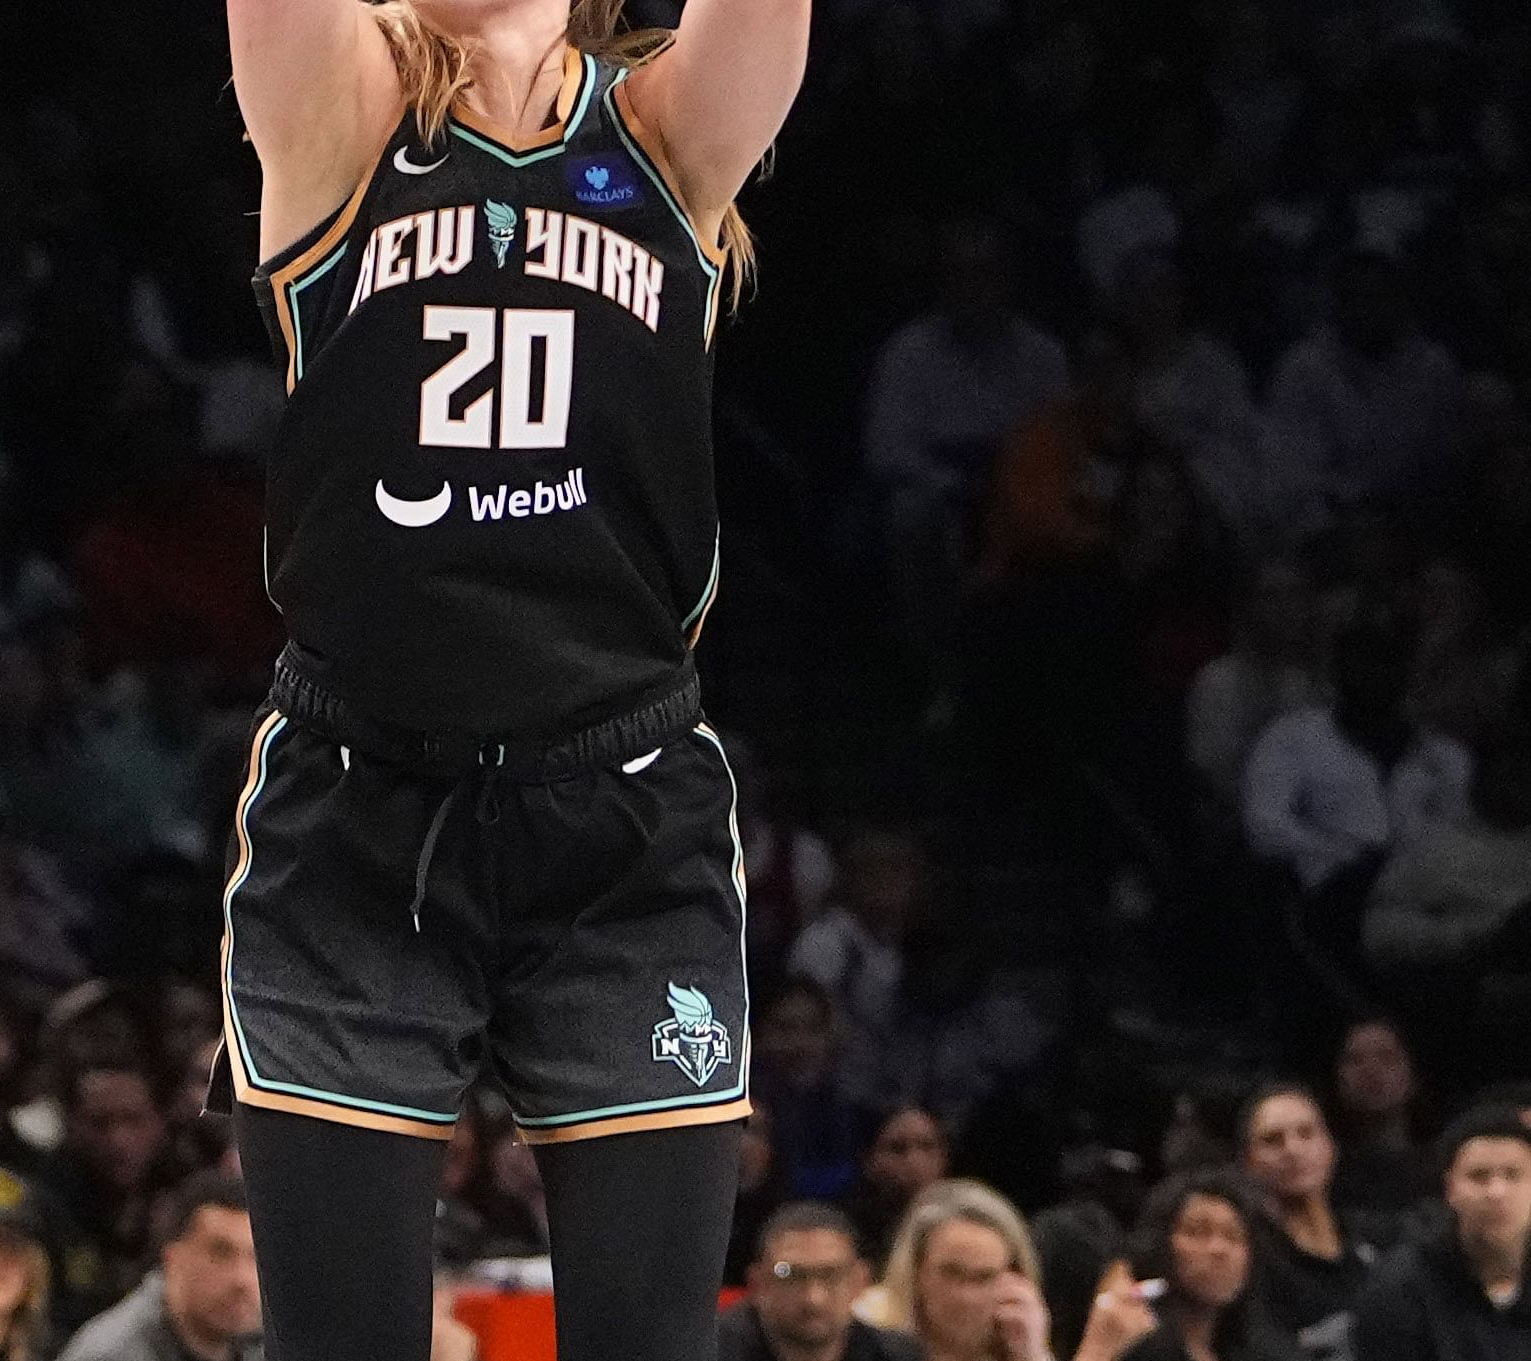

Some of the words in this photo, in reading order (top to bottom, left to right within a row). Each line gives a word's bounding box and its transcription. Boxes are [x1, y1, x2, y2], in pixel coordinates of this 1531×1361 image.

[348, 205, 475, 316] NEW
[525, 206, 664, 333] YORK
[419, 304, 575, 450] 20
[468, 467, 587, 522] Webull
